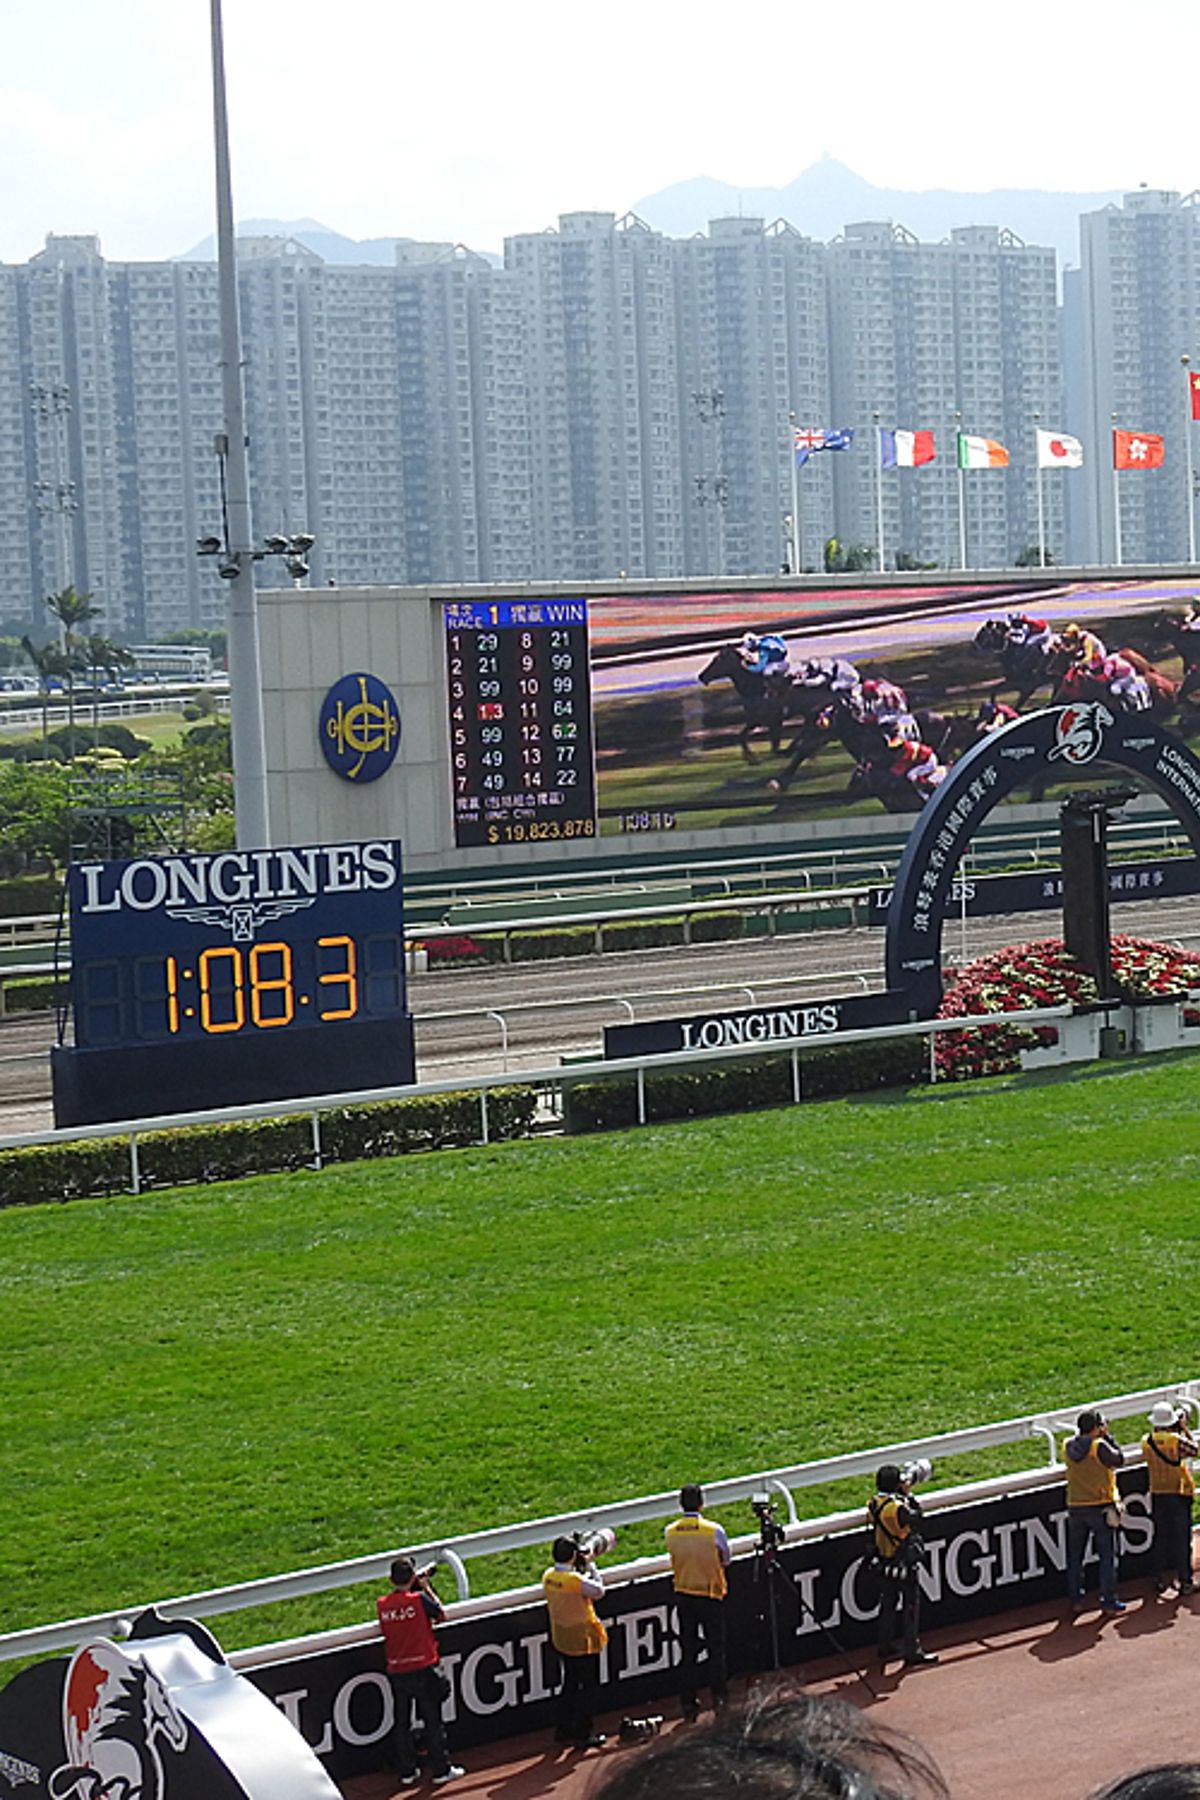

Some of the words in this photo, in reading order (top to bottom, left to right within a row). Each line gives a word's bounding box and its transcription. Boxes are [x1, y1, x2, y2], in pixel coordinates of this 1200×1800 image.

[489, 604, 498, 625] 1
[546, 604, 584, 621] WIN
[452, 635, 460, 651] 1
[477, 633, 498, 651] 29
[521, 632, 532, 649] 8
[551, 631, 570, 647] 21
[451, 658, 462, 675] 2
[479, 657, 498, 673] 21
[522, 655, 533, 672] 9
[551, 653, 572, 670] 99
[453, 682, 464, 698] 3
[479, 681, 500, 697] 99
[520, 678, 538, 694] 10
[553, 677, 573, 694] 99
[453, 706, 464, 720] 4
[520, 703, 537, 718] 11
[553, 700, 573, 716] 64
[455, 729, 466, 745] 5
[481, 727, 502, 743] 99
[521, 725, 540, 740] 12
[455, 753, 467, 769] 6
[481, 750, 503, 767] 49
[522, 748, 541, 764] 13
[556, 746, 575, 762] 77
[457, 776, 467, 792] 7
[483, 774, 504, 790] 49
[523, 772, 541, 788] 14
[556, 769, 577, 786] 22
[488, 825, 499, 844] $
[80, 843, 397, 914] LONGINES
[680, 1004, 840, 1051] LONGINES
[381, 1605, 417, 1621] HKJC
